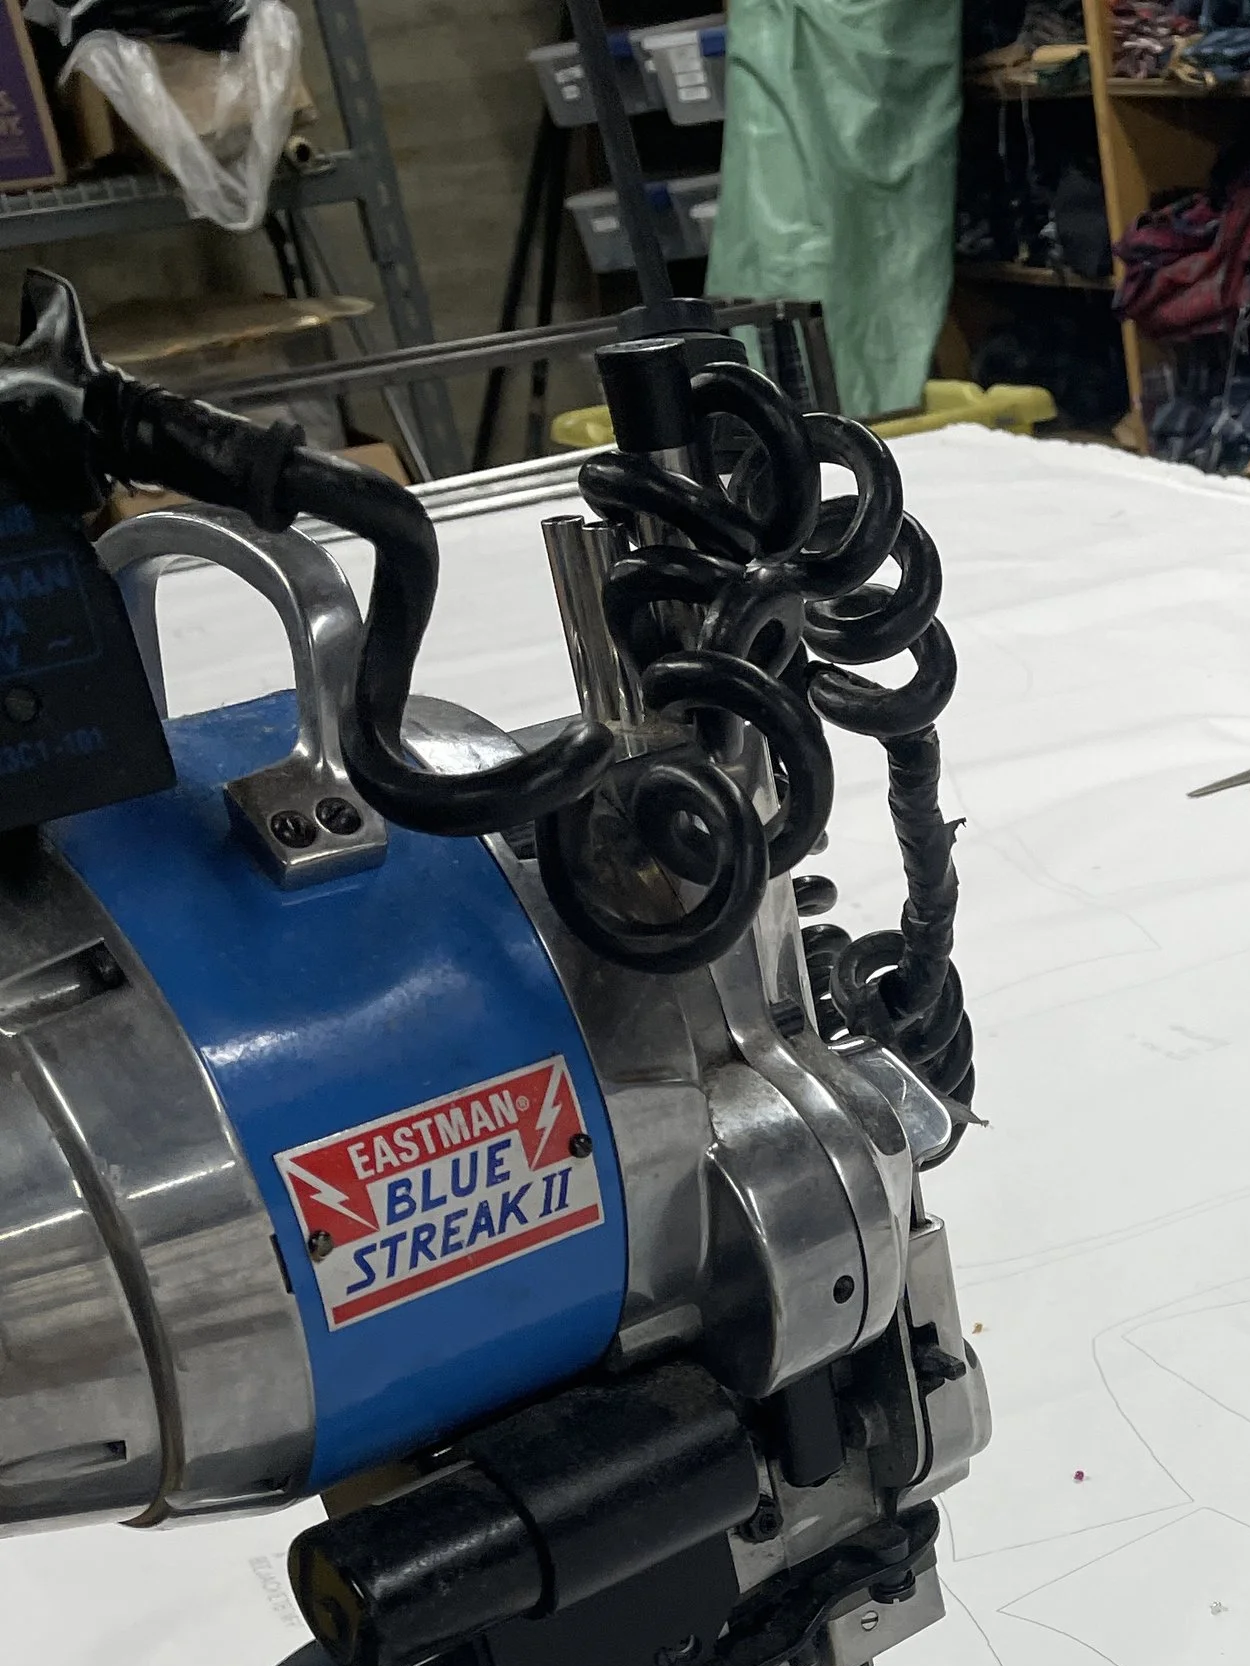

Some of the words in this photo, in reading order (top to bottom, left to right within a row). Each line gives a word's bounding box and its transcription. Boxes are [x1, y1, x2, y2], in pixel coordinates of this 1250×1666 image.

[386, 1138, 511, 1226] BLUE
[538, 1167, 573, 1220] II
[346, 1181, 534, 1295] STREAK
